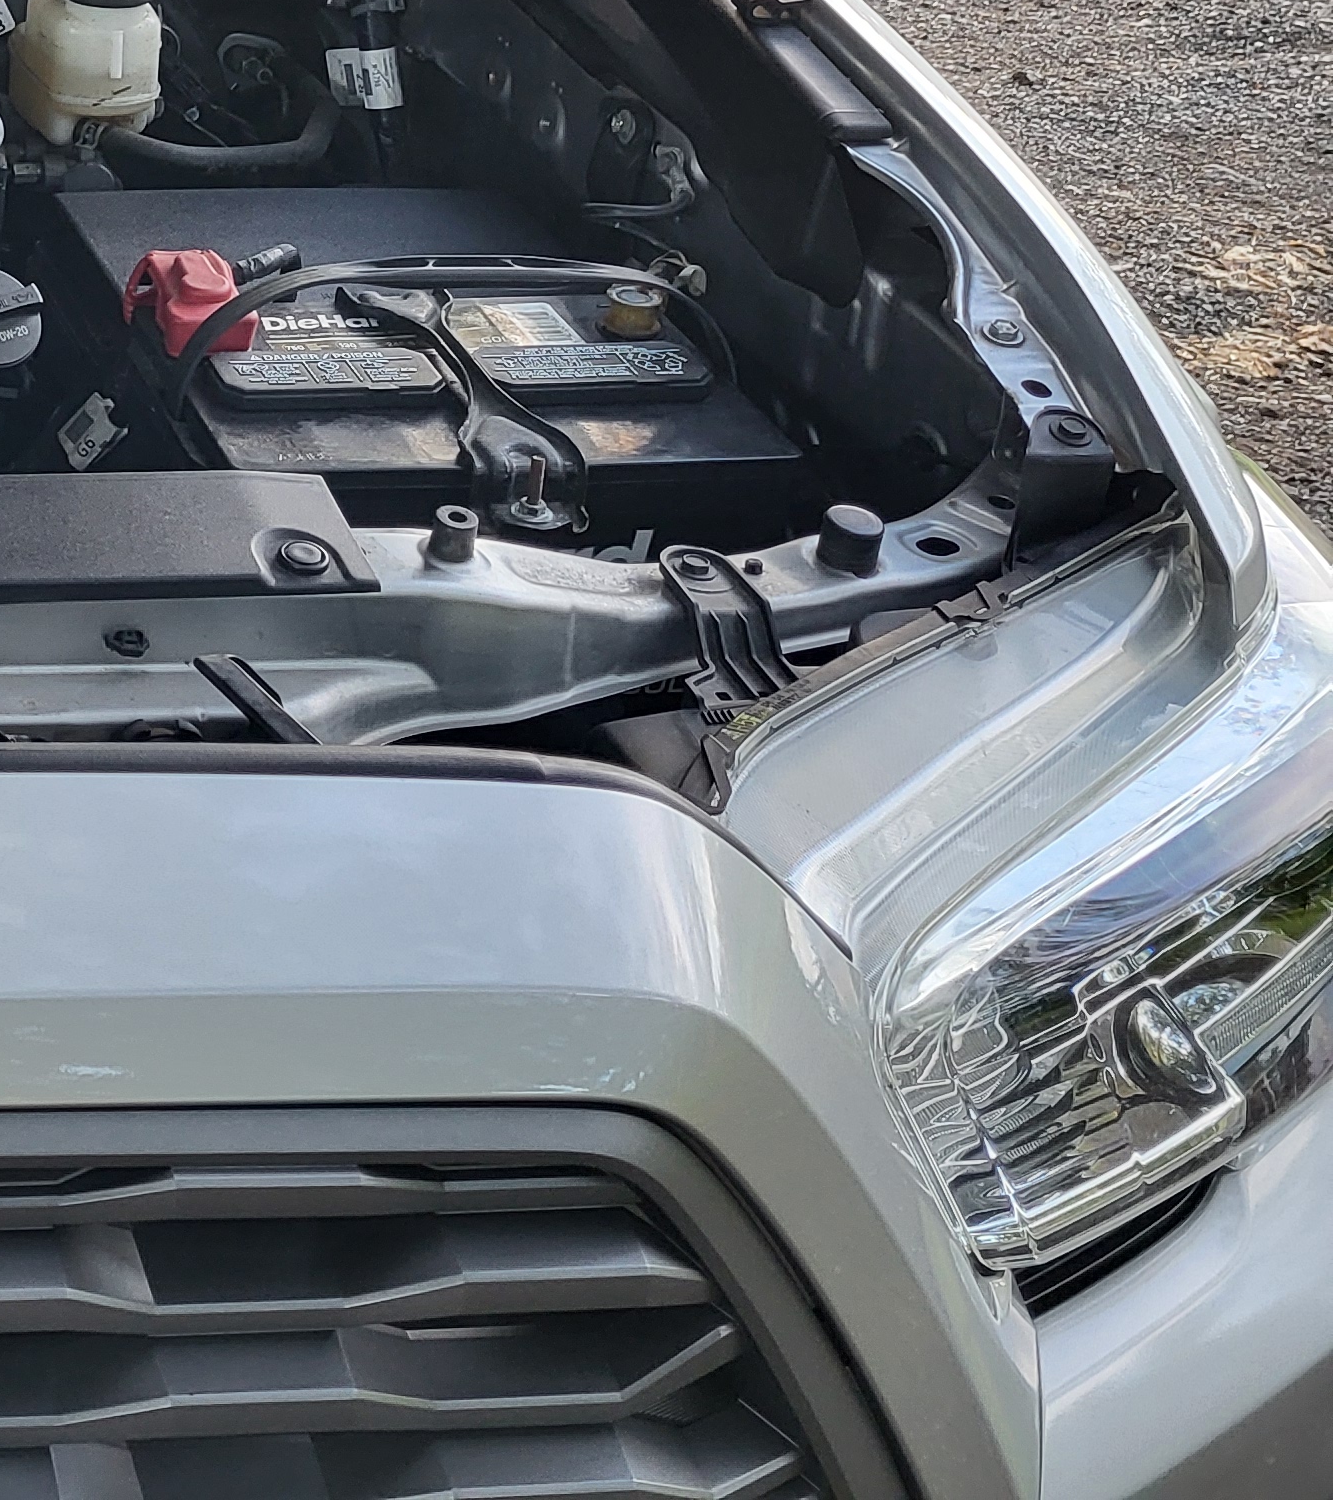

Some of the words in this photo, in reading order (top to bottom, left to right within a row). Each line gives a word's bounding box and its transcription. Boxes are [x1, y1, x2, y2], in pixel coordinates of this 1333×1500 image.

[261, 313, 380, 331] DieHar
[262, 353, 320, 361] DANGER
[331, 351, 384, 360] POISON
[76, 435, 96, 458] G6
